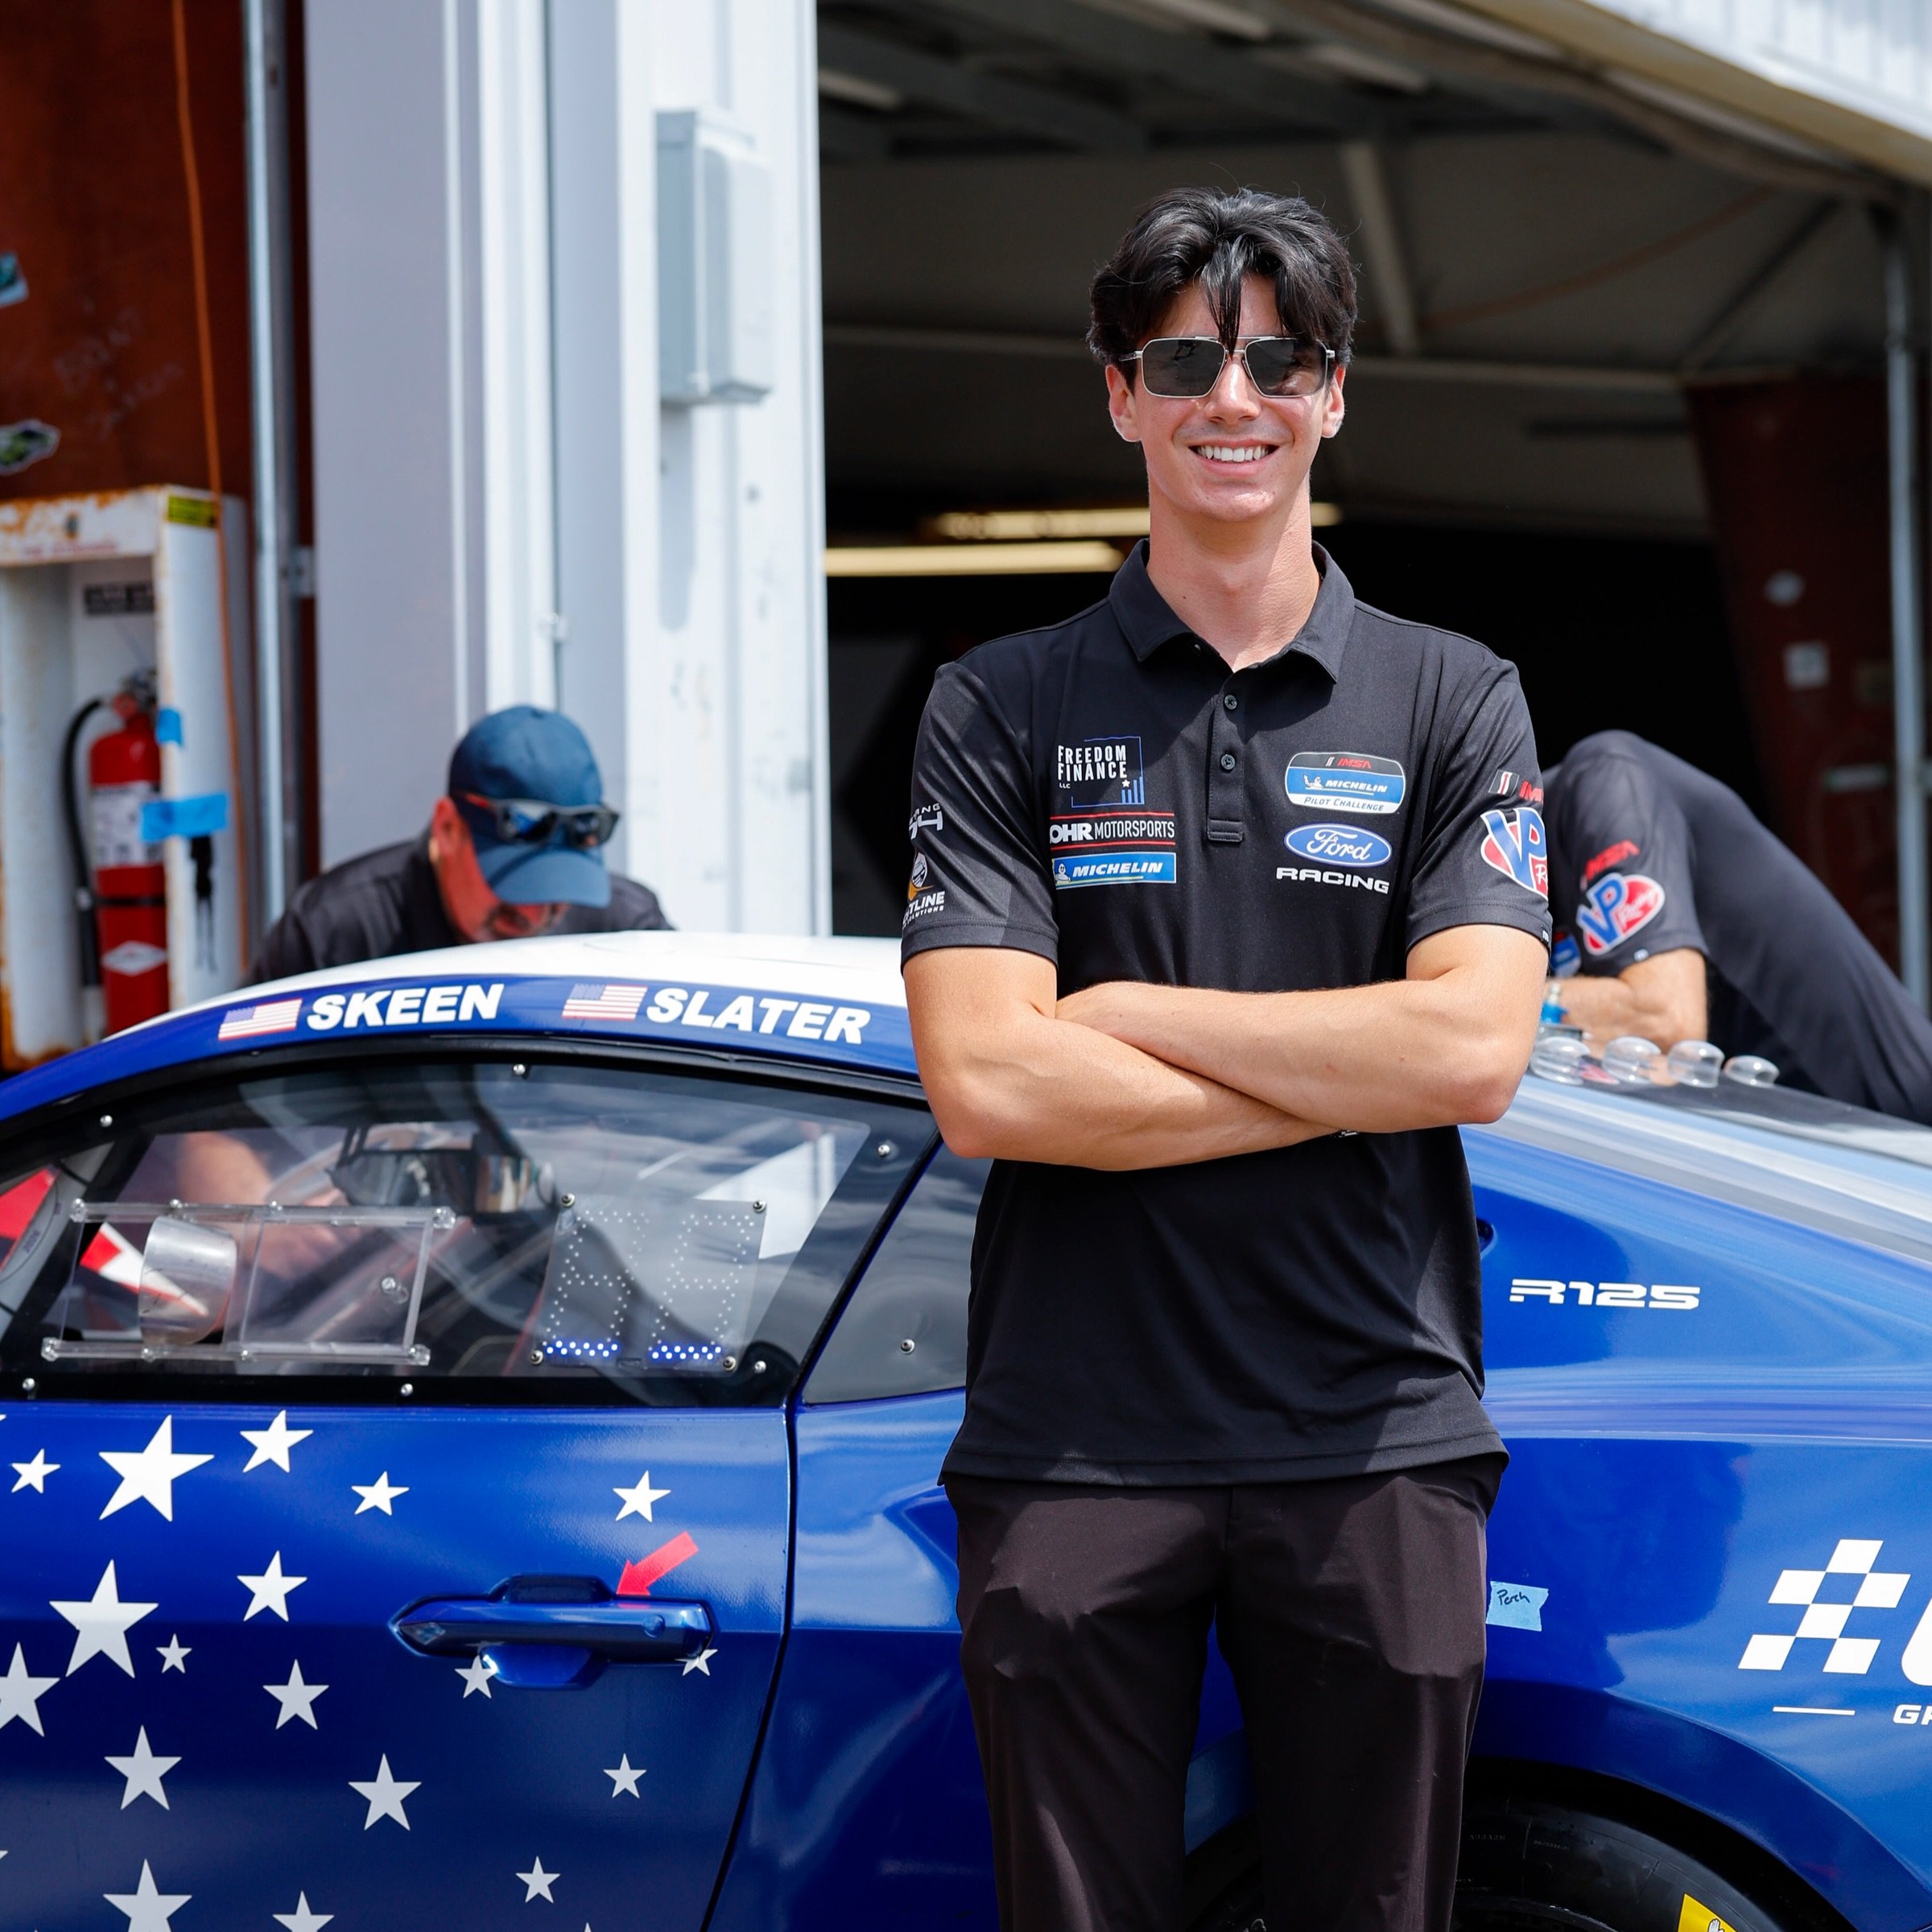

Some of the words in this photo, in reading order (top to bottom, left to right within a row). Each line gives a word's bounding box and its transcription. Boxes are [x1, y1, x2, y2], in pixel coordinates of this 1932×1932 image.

[1058, 745, 1126, 765] FREEDOM
[1337, 757, 1372, 769] IMSA
[1058, 761, 1127, 782] FINANCE
[1325, 779, 1388, 793] MICHELIN
[1519, 779, 1544, 803] IM
[1303, 796, 1331, 805] PILOT
[1333, 798, 1384, 811] CHALLENGE
[1050, 823, 1094, 844] OHR
[1094, 820, 1174, 840] MOTORSPORTS
[1307, 828, 1373, 861] Ford
[1480, 807, 1547, 891] VP
[1072, 862, 1163, 877] MICHELIN
[1276, 867, 1390, 894] RACING
[306, 984, 505, 1030] SKEEN
[646, 988, 871, 1044] SLATER
[1509, 1278, 1700, 1310] R125
